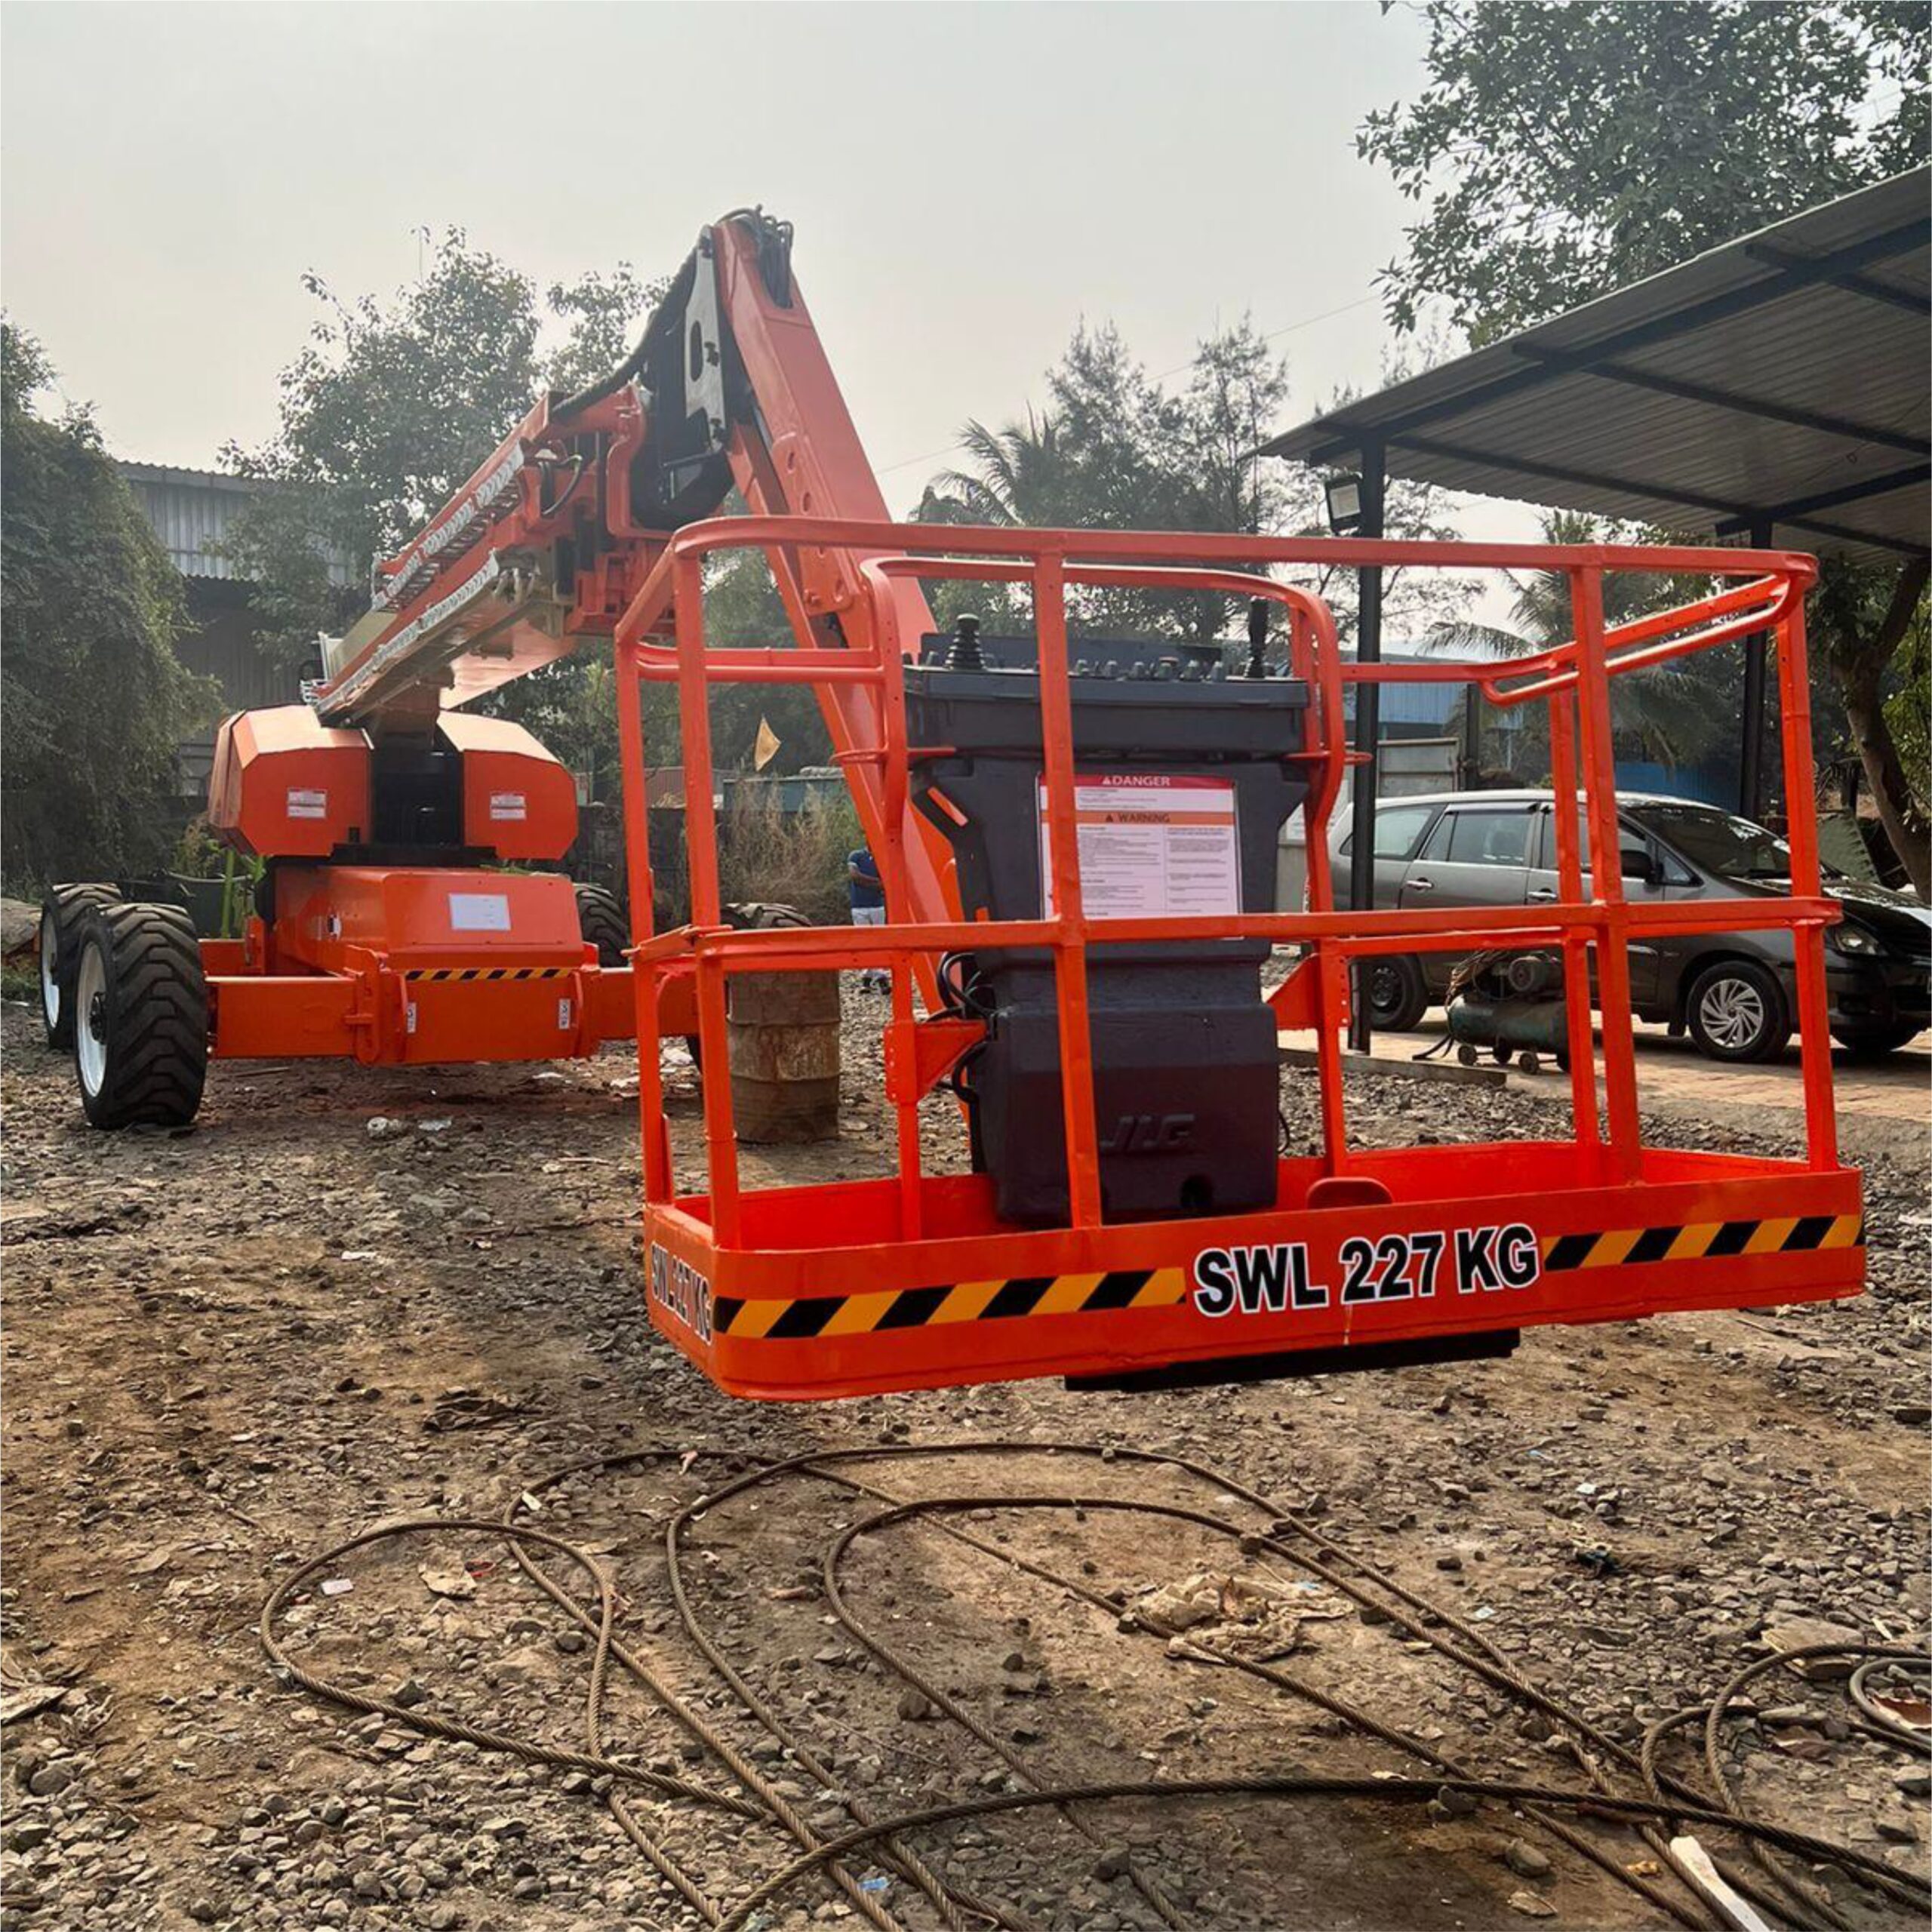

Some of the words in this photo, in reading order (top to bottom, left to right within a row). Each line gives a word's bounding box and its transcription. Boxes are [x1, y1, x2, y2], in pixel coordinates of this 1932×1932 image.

[1112, 775, 1171, 786] DANGER
[1118, 812, 1171, 823] WARNING
[1099, 1112, 1196, 1152] JLG
[1193, 1242, 1329, 1318] SWL
[1339, 1231, 1446, 1305] 227
[1454, 1223, 1540, 1294] KG
